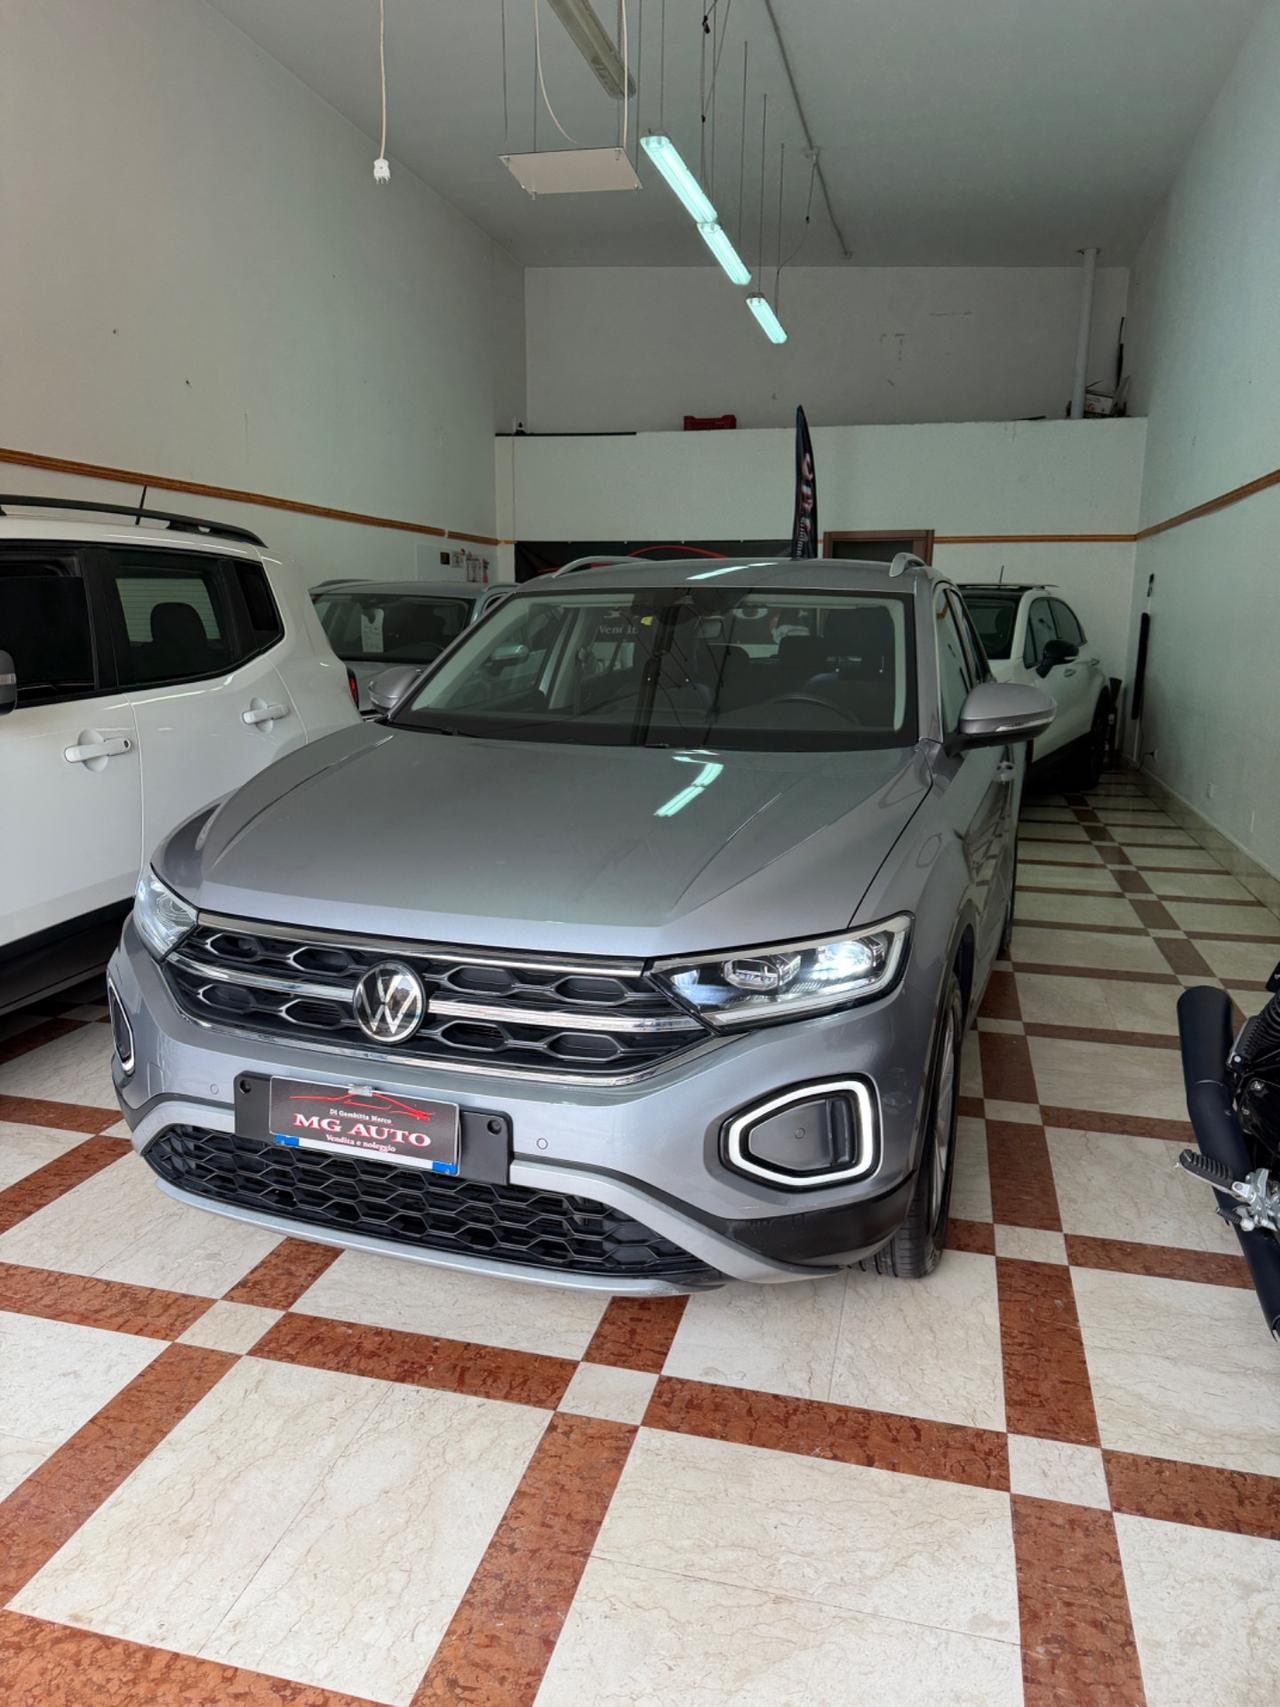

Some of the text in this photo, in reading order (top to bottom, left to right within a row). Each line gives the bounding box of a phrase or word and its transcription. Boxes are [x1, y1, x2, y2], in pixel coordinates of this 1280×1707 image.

[293, 1112, 431, 1147] MG AUTO
[326, 1134, 354, 1146] Vendita
[362, 1140, 396, 1153] noleggio
